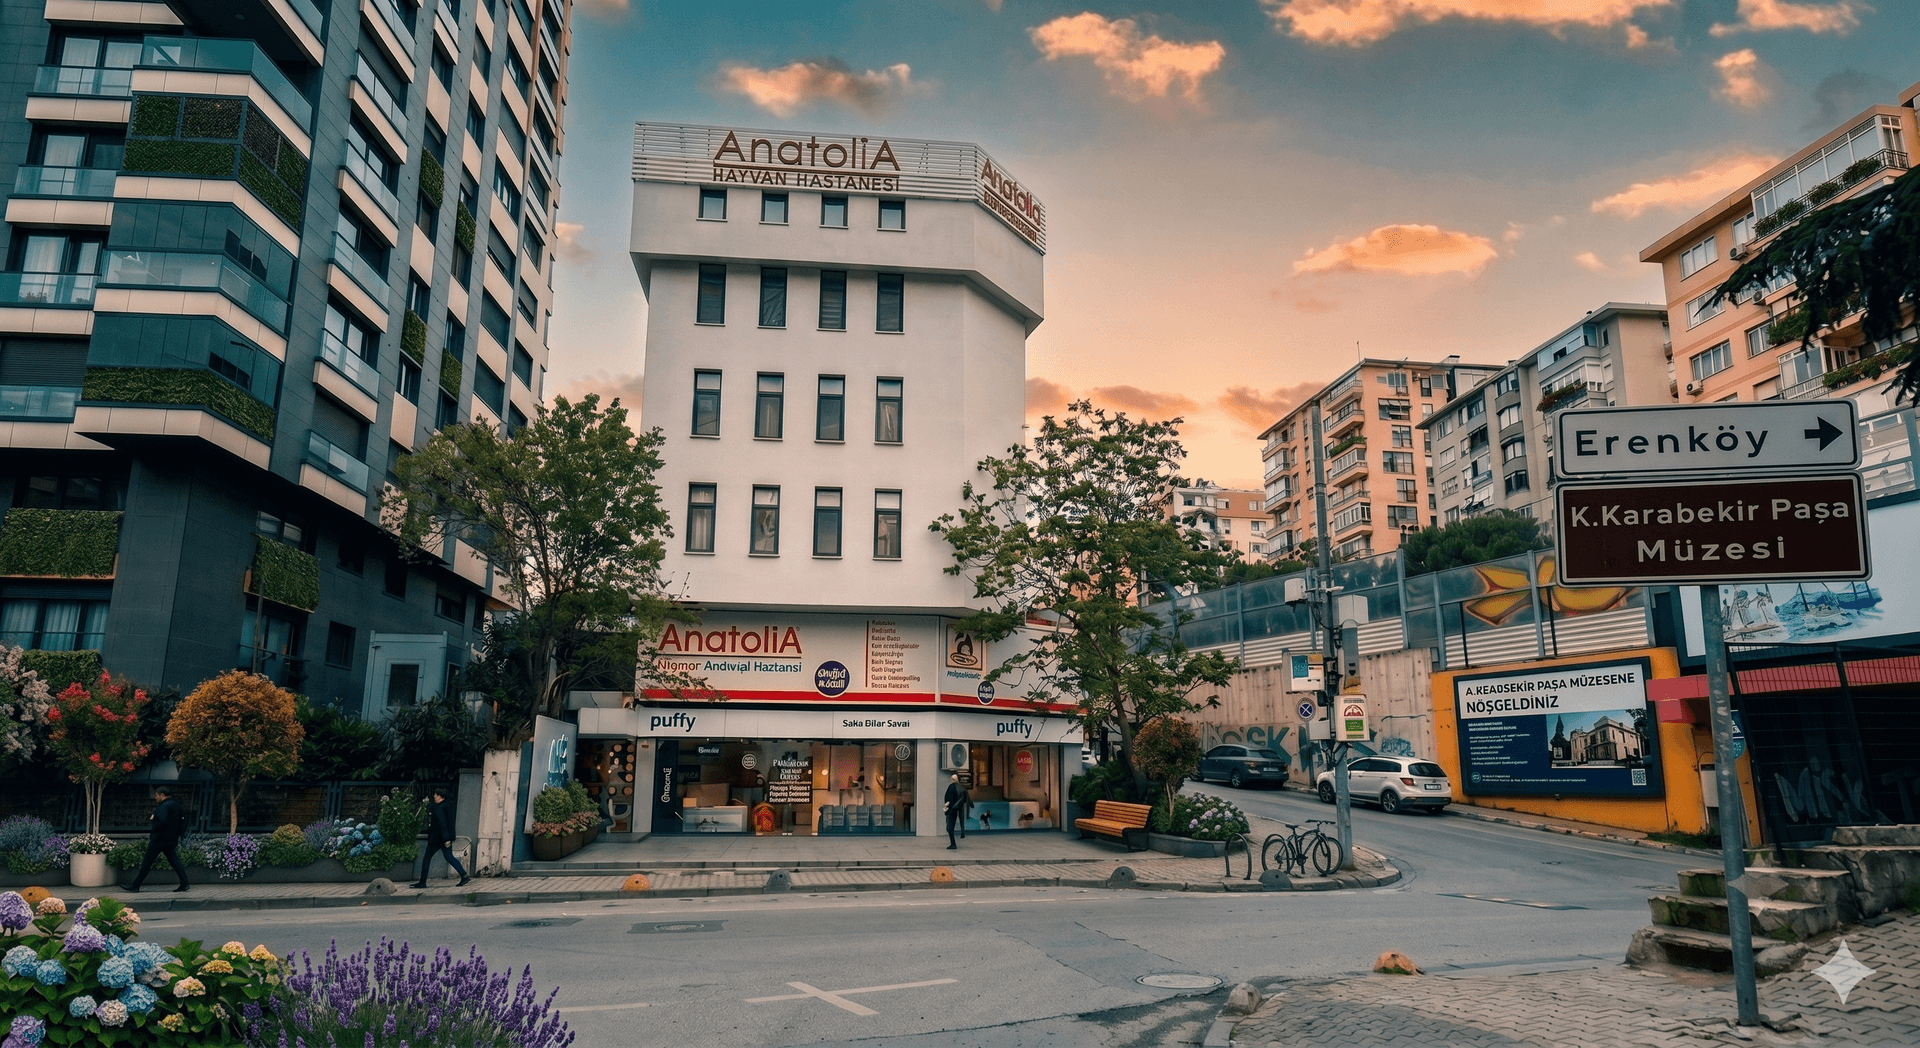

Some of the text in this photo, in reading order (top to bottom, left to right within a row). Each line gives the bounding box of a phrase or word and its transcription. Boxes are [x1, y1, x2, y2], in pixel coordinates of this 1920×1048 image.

[713, 168, 787, 185] HAYVAN
[1576, 425, 1768, 458] Erenköy
[1571, 498, 1850, 527] K.Karabekir Paşa
[1637, 536, 1785, 562] Müzesi
[1537, 679, 1567, 692] PAŞA
[650, 713, 696, 732] puffy
[842, 719, 910, 728] Saka Bilar Savai
[996, 719, 1032, 739] puffy
